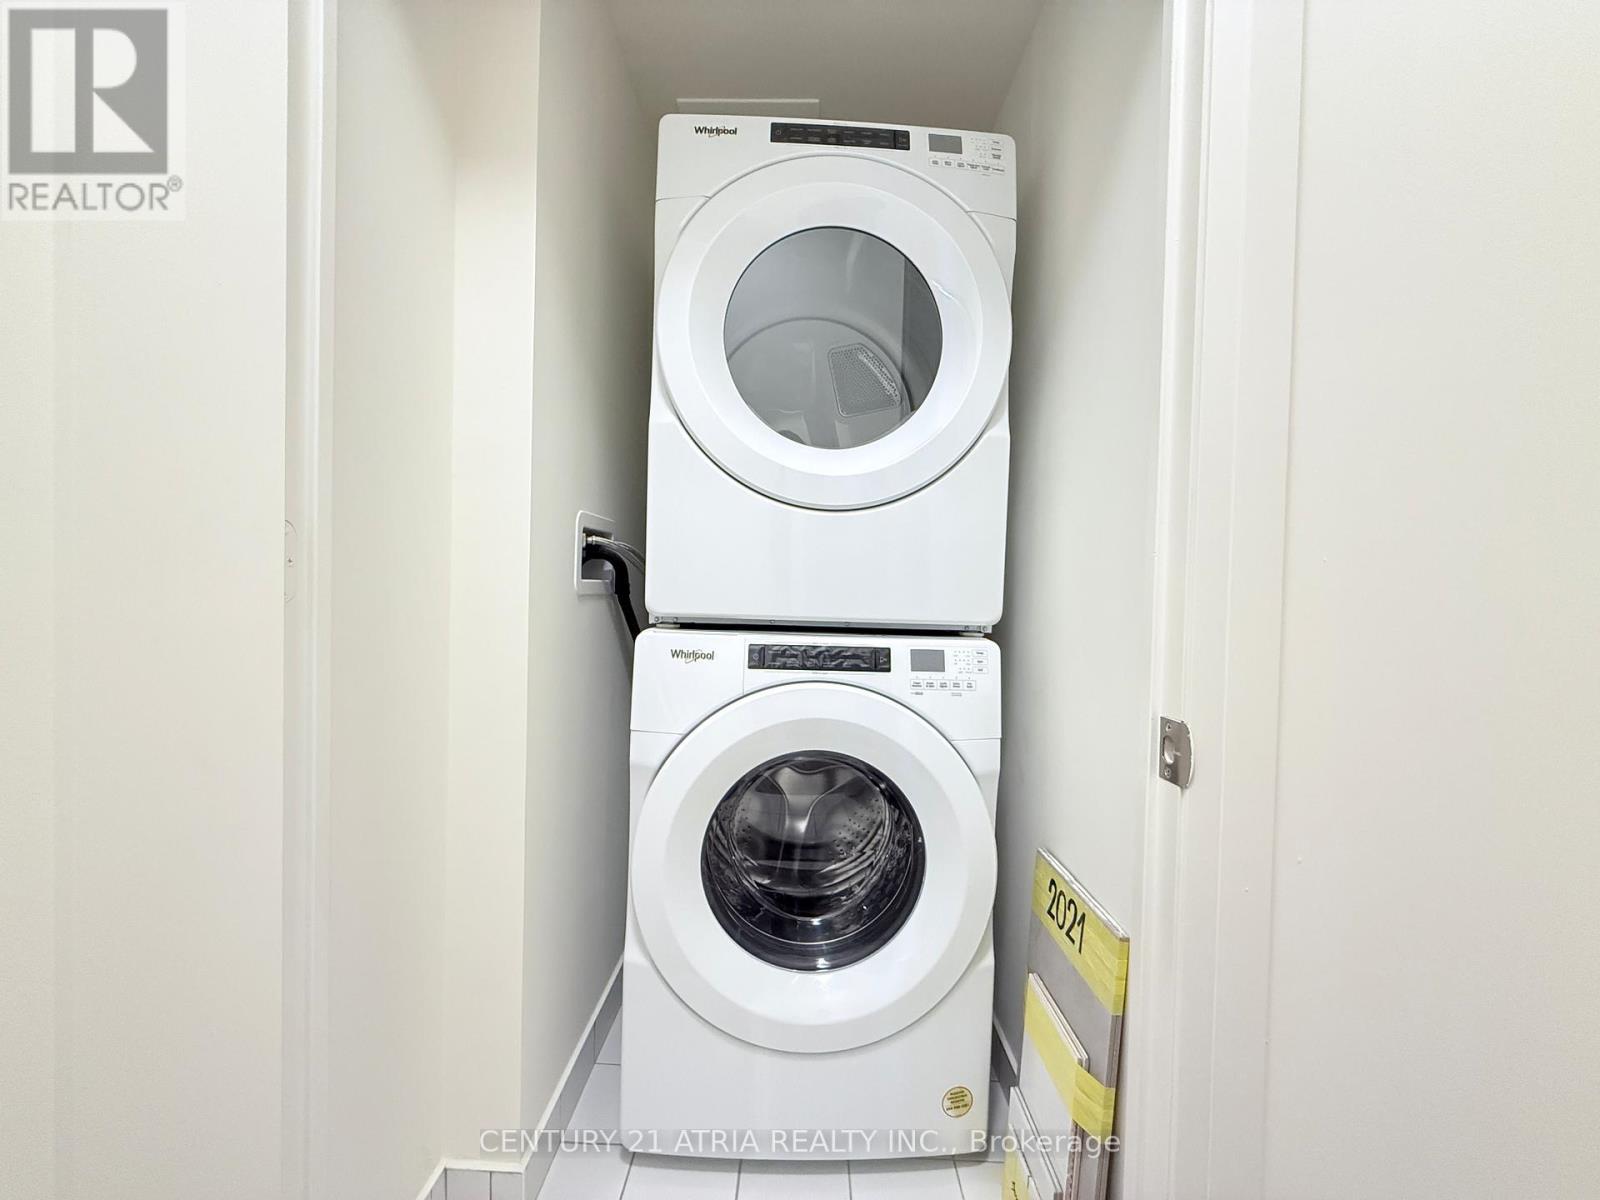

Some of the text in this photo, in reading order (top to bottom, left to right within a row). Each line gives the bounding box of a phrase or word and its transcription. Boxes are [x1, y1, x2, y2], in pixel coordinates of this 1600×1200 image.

[694, 126, 738, 137] Whirlpool
[671, 649, 715, 663] Whirlpool
[1046, 878, 1087, 955] 2021
